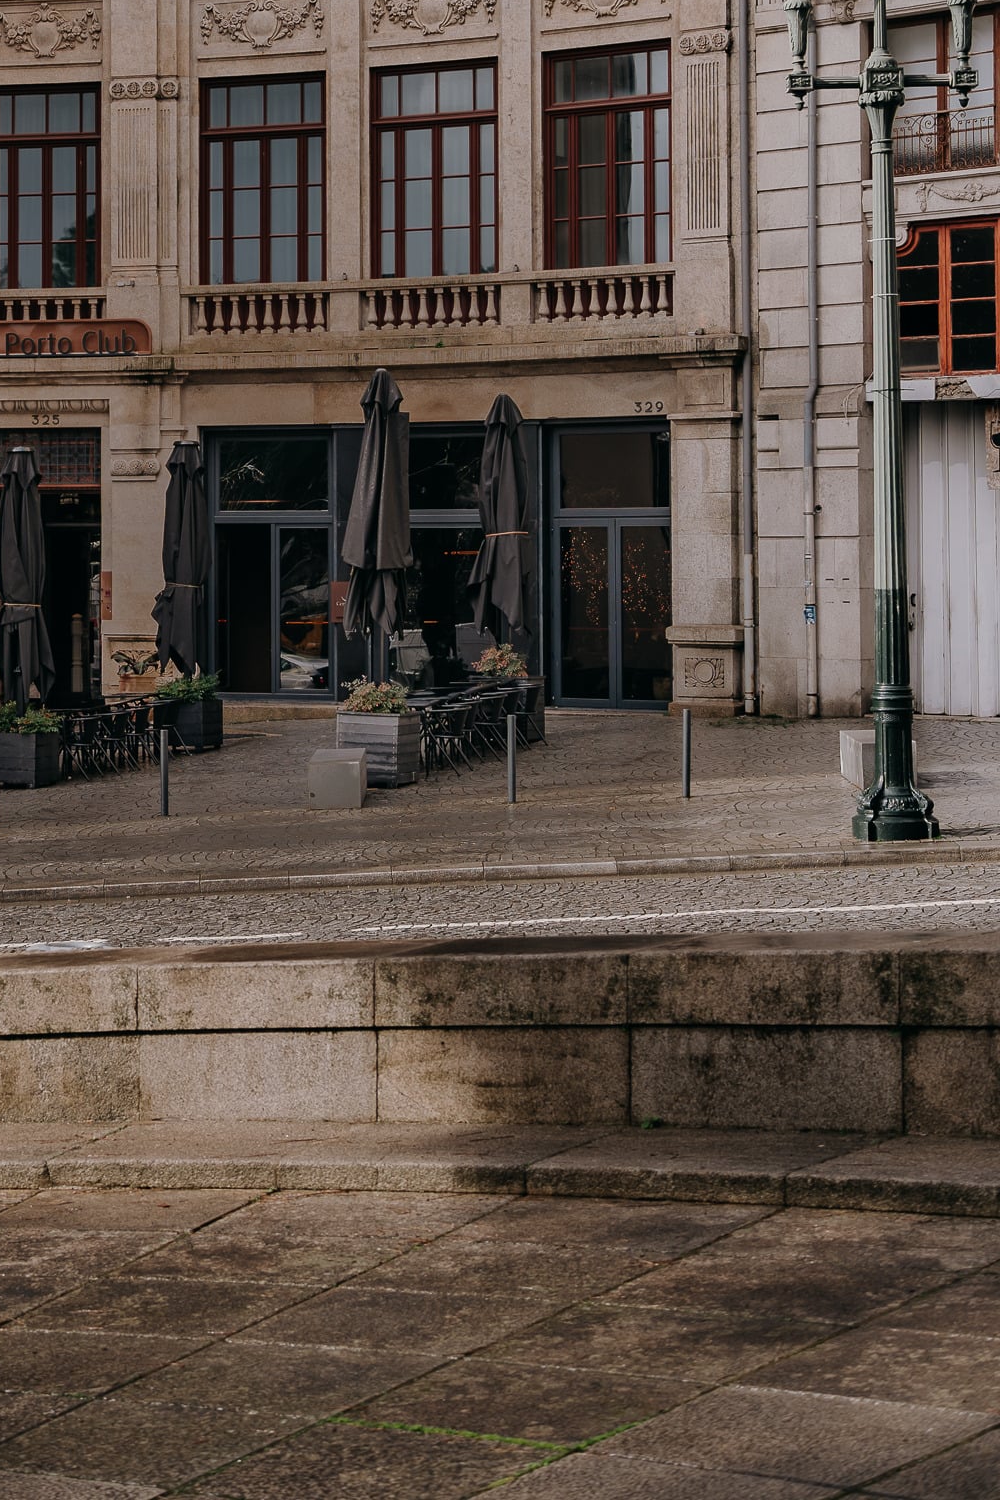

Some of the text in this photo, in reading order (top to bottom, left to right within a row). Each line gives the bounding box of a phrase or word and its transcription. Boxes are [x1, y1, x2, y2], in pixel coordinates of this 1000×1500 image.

[5, 332, 72, 356] Porto
[82, 329, 136, 355] Club
[634, 401, 664, 413] 329
[31, 414, 60, 425] 325
